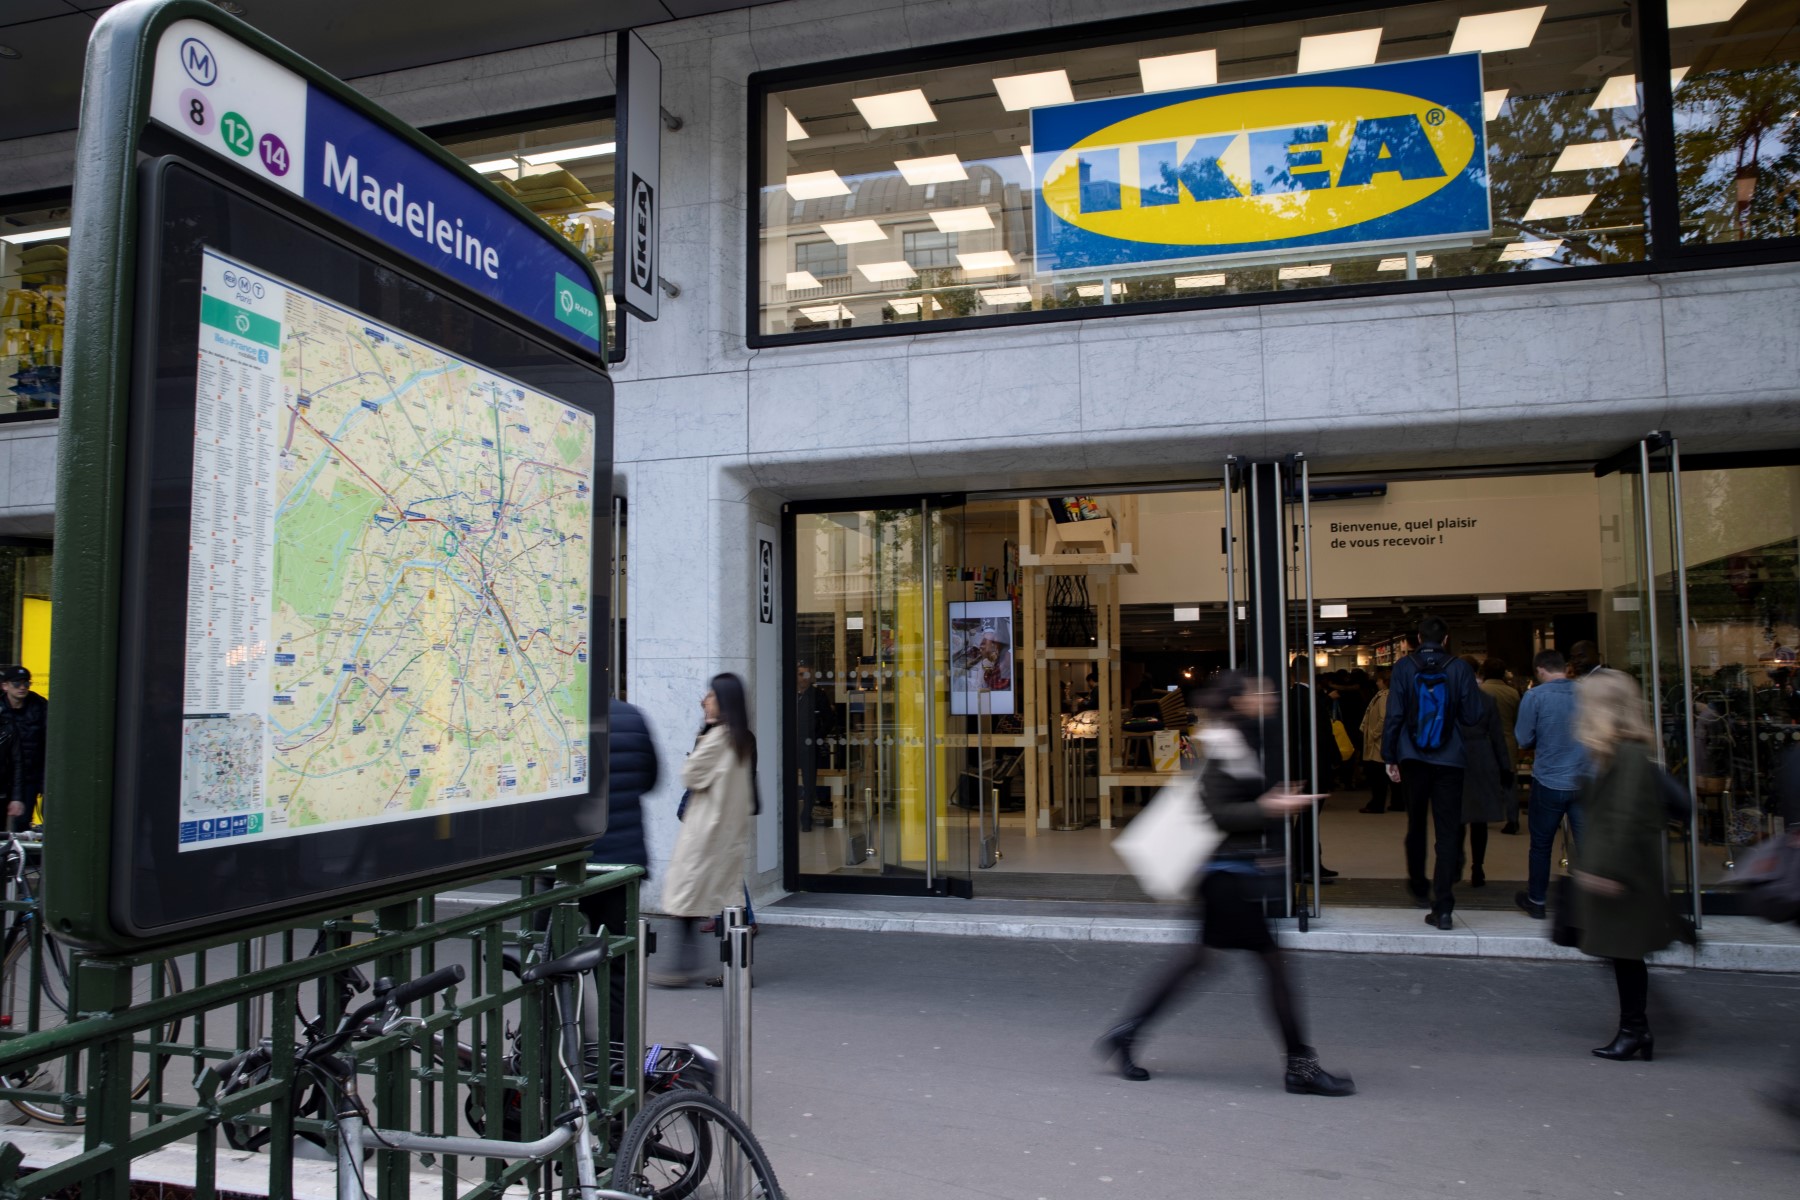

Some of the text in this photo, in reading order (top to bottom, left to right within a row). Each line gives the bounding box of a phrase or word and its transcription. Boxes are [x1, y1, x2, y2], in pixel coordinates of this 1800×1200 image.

[190, 98, 287, 172] 8 12 14
[1077, 113, 1448, 214] IKEA
[322, 140, 499, 280] Madeleine
[637, 191, 647, 279] IKEA
[236, 292, 252, 305] Paris
[574, 302, 594, 318] RATP
[1330, 517, 1477, 533] Bienvenue, quel plaisir
[1331, 538, 1346, 549] de
[1349, 538, 1380, 548] vous
[1383, 535, 1436, 547] recevoir
